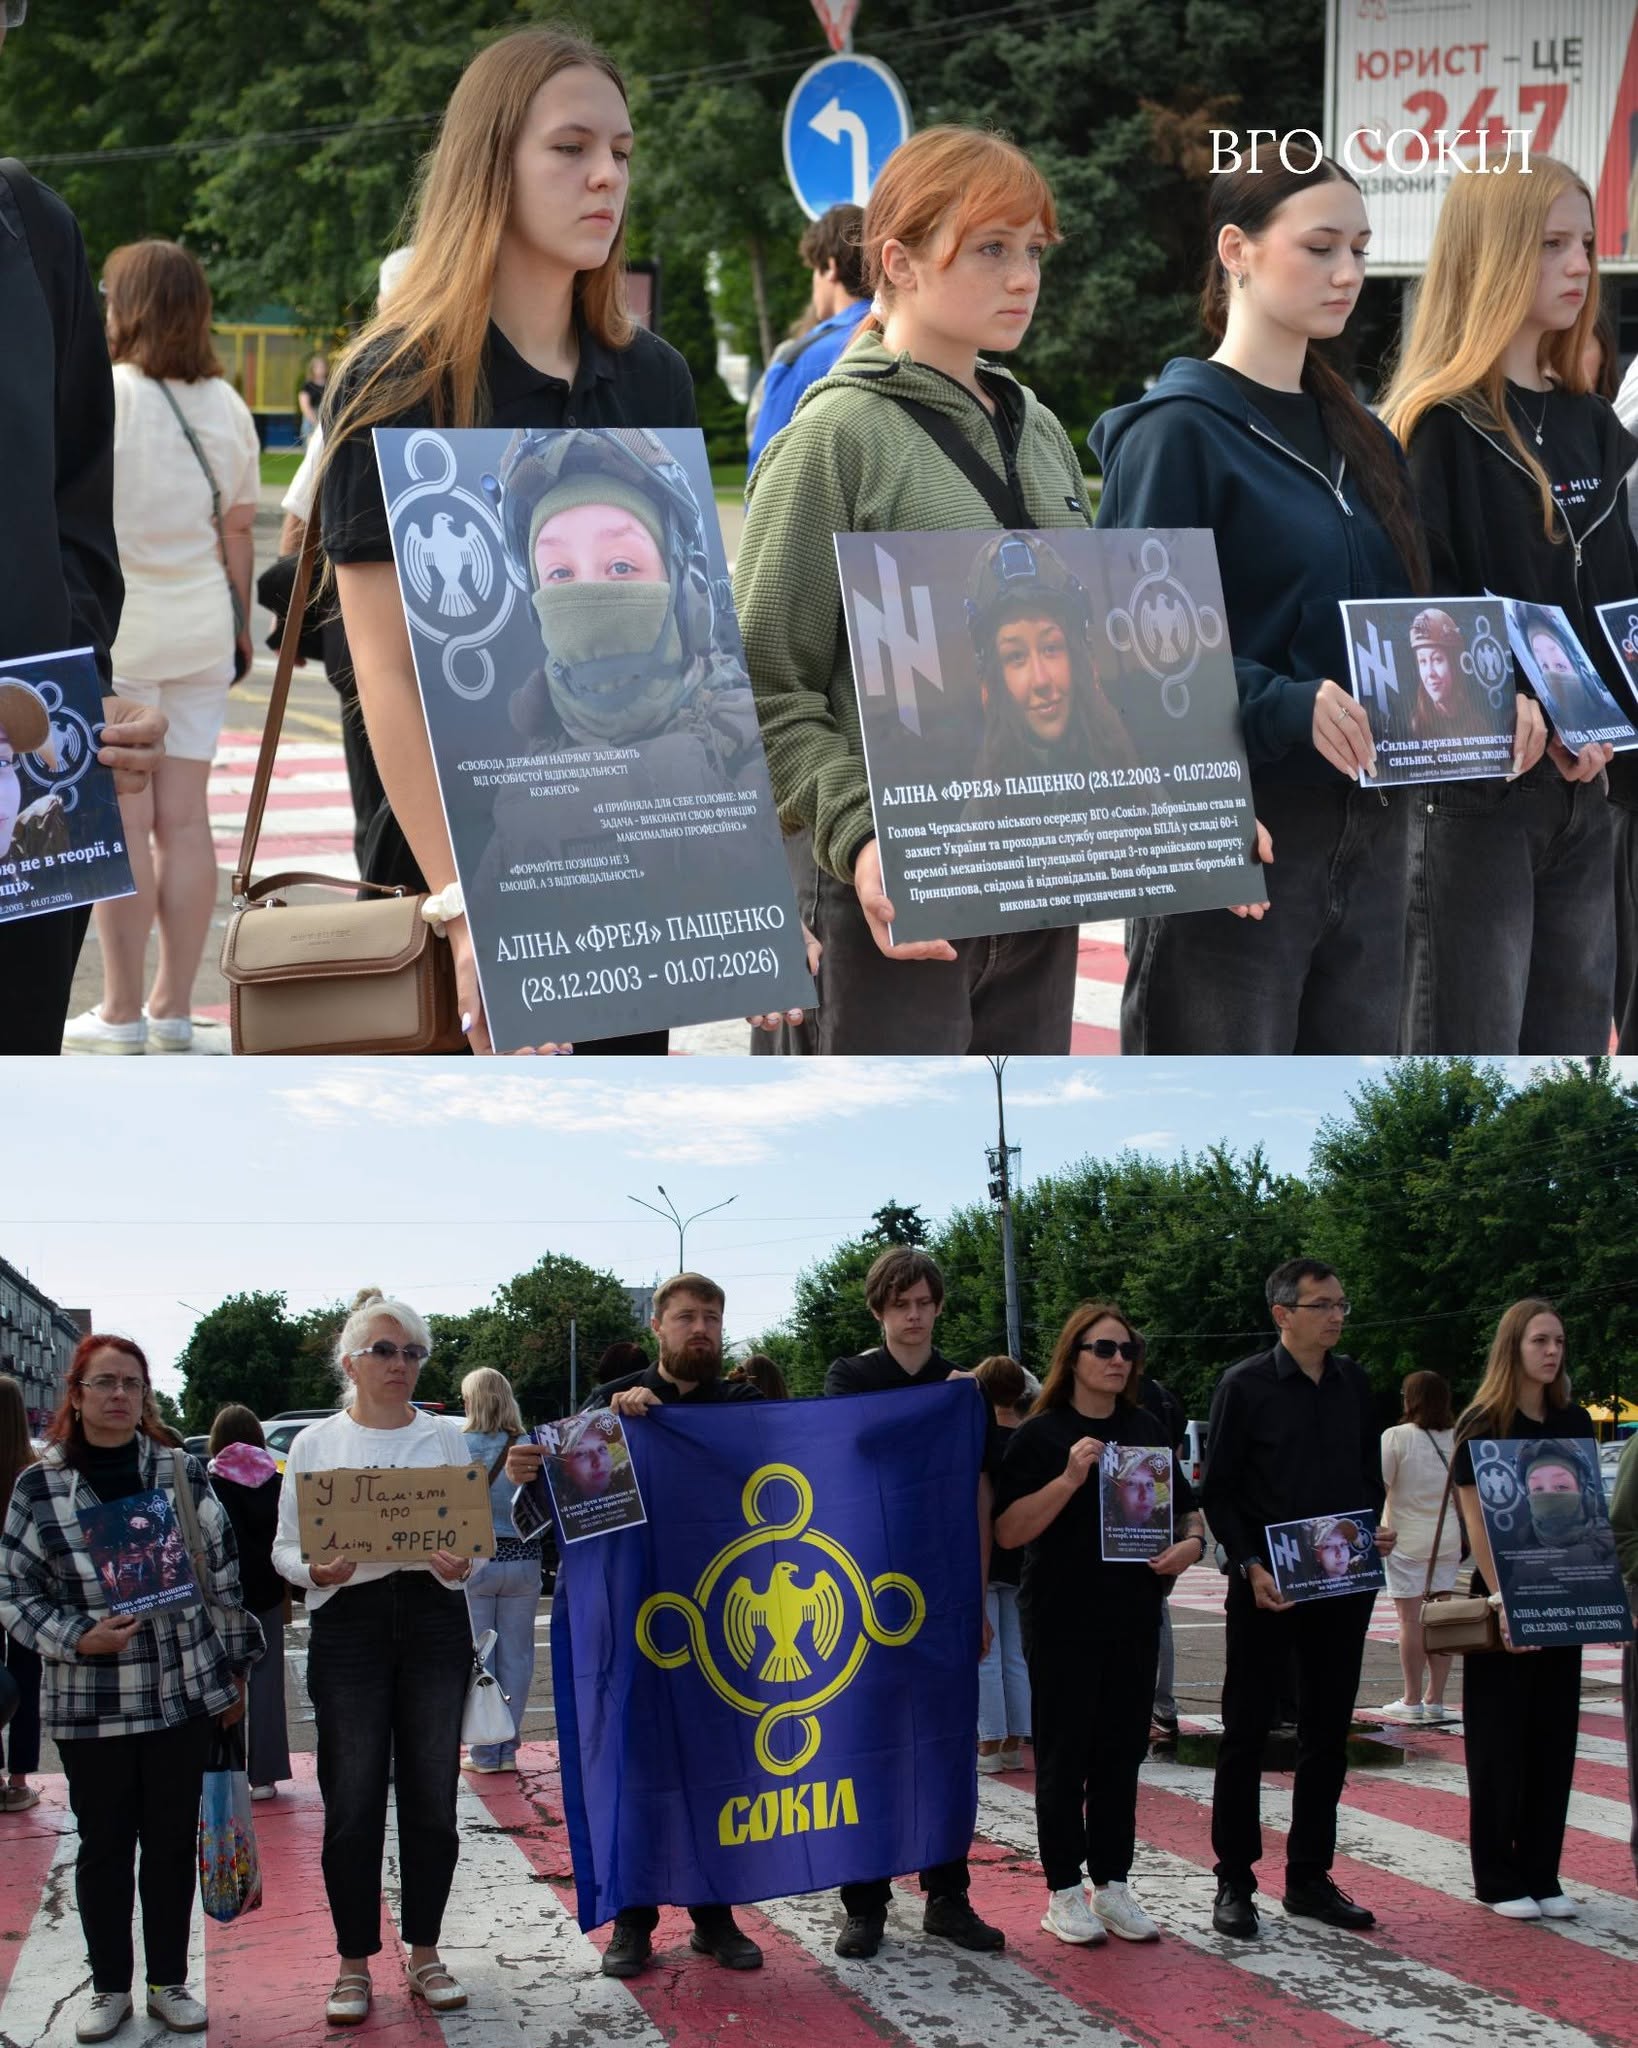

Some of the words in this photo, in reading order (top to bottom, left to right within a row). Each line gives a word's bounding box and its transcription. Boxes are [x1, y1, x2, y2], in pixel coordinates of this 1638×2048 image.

[1356, 43, 1489, 81] ЮРИСТ
[1532, 38, 1582, 75] ЦЕ
[1402, 83, 1569, 162] 247
[1570, 478, 1602, 492] HILF
[1568, 494, 1586, 505] 1985
[1376, 739, 1420, 753] «Сильна
[1421, 737, 1461, 751] держава
[1585, 724, 1636, 742] ПАЩЕНКО
[457, 758, 504, 772] «СВОБОДА
[505, 754, 548, 768] ДЕРЖАВИ
[549, 751, 591, 765] НАПРЯМУ
[592, 748, 640, 761] ЗАЛЕЖИТЬ
[1389, 755, 1436, 767] сильних,
[1437, 751, 1481, 765] свідомих
[473, 775, 490, 787] ВІД
[490, 770, 543, 785] ОСОБИСТОЇ
[544, 764, 628, 782] ВІДПОВІДАЛЬНОСТІ
[881, 783, 939, 807] АЛІНА
[941, 780, 1001, 802] «ФРЕЯ»
[1004, 772, 1086, 798] ПАЩЕНКО
[1088, 766, 1161, 795] (28.12.2003
[1173, 759, 1241, 783] 01.07.2026)
[529, 785, 580, 798] КОЖНОГО»
[592, 803, 604, 814] «Я
[605, 799, 653, 813] ПРИЙНЯЛА
[654, 797, 671, 810] ДЛЯ
[672, 795, 694, 807] СЕБЕ
[695, 791, 737, 805] ГОЛОВНЕ:
[738, 789, 758, 801] МОЯ
[600, 817, 634, 829] ЗАДАЧА
[640, 812, 687, 825] ВИКОНАТИ
[688, 808, 715, 821] СВОЮ
[715, 805, 757, 819] ФУНКЦІЮ
[887, 825, 927, 840] Голова
[928, 819, 995, 837] Черкаського
[997, 815, 1042, 830] міського
[1043, 811, 1088, 827] осередку
[1089, 808, 1109, 821] ВГО
[1111, 804, 1150, 820] «Сокіл».
[1151, 800, 1208, 817] Добровільно
[1209, 798, 1234, 811] стала
[1235, 797, 1246, 808] на
[616, 828, 683, 843] МАКСИМАЛЬНО
[684, 821, 747, 836] ПРОФЕСІЙНО.»
[904, 846, 942, 859] захист
[942, 840, 987, 858] України
[988, 841, 1001, 851] та
[1002, 834, 1057, 853] проходила
[1058, 829, 1095, 846] службу
[1096, 826, 1151, 843] оператором
[1153, 821, 1181, 835] БПЛА
[1181, 824, 1191, 836] у
[1189, 818, 1219, 832] складі
[20, 858, 41, 872] не
[44, 855, 55, 867] в
[57, 840, 110, 863] теорії,
[113, 841, 123, 854] а
[510, 859, 564, 876] «ФОРМУЙТЕ
[565, 856, 608, 870] ПОЗИЦІЮ
[609, 855, 622, 865] НЕ
[622, 854, 630, 864] З
[903, 864, 948, 883] окремої
[950, 856, 1025, 875] механізованої
[1026, 849, 1086, 870] Інгулецької
[1087, 848, 1127, 865] бригади
[1128, 845, 1149, 857] 3-го
[1150, 841, 1206, 859] армійського
[1207, 837, 1245, 852] корпусу.
[499, 877, 540, 892] ЕМОЦІЙ,
[540, 879, 548, 889] А
[548, 877, 554, 887] З
[555, 868, 645, 887] ВІДПОВІДАЛЬНОСТІ.»
[909, 885, 983, 903] Принципова,
[983, 878, 1025, 893] свідома
[1026, 876, 1034, 888] й
[1036, 871, 1109, 890] відповідальна.
[1110, 867, 1134, 880] Вона
[1135, 864, 1168, 880] обрала
[1169, 862, 1195, 873] шлях
[1195, 857, 1237, 873] боротьби
[1238, 854, 1244, 866] й
[30, 892, 73, 908] 01.07.2026)
[999, 897, 1048, 912] виконала
[1049, 895, 1072, 907] своє
[1073, 889, 1137, 907] призначення
[1145, 883, 1177, 896] честю.
[496, 930, 571, 963] АЛІНА
[575, 920, 662, 953] «ФРЕЯ»
[665, 904, 785, 942] ПАЩЕНКО
[521, 965, 643, 1012] (28.12.2003
[664, 947, 780, 986] 01.07.2026)
[315, 1476, 334, 1506] У
[380, 1506, 410, 1522] про
[321, 1531, 373, 1552] Аліну
[391, 1529, 457, 1551] ФРЕЮ
[1512, 1608, 1541, 1619] АЛІНА
[1542, 1606, 1576, 1618] «ФРЕЯ»
[1577, 1604, 1625, 1617] ПАЩЕНКО
[1521, 1622, 1569, 1635] (28.12.2003
[1575, 1619, 1622, 1631] 01.07.2026)
[718, 1777, 860, 1846] СОКІЛ
